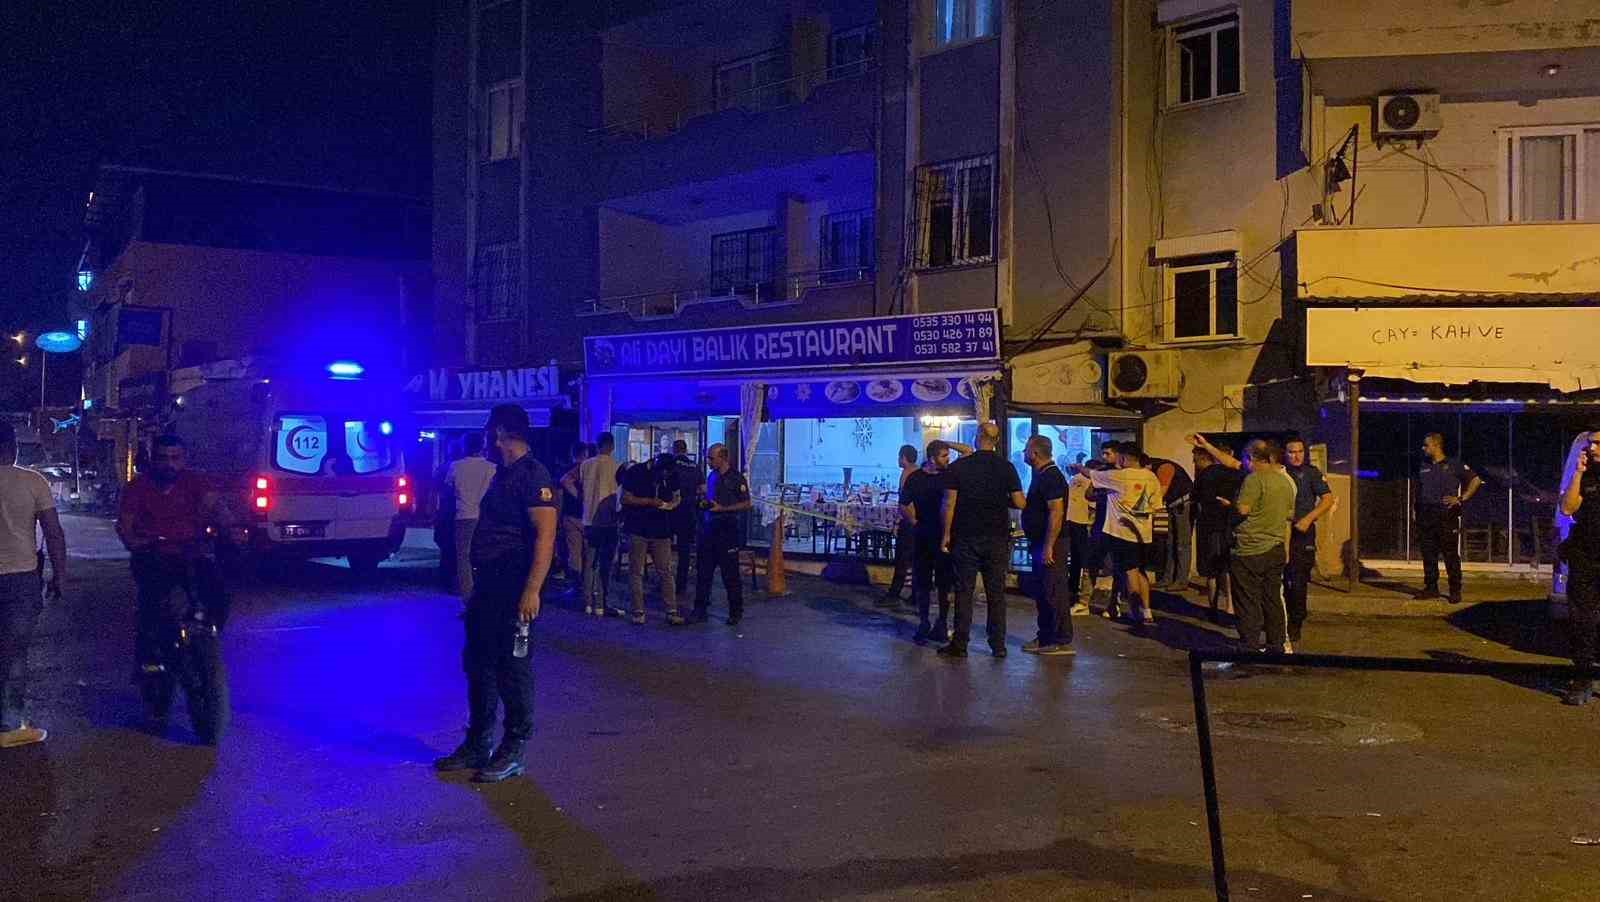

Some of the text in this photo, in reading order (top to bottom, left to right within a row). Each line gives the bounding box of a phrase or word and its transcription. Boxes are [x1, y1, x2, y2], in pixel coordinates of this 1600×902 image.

[941, 315, 962, 326] 330
[964, 313, 975, 324] 14
[978, 313, 992, 324] 94
[913, 327, 993, 341] 0530 426 71 89
[692, 335, 749, 362] BALIK
[754, 325, 896, 359] RESTAURANT
[914, 341, 993, 354] 0531 582 37 41
[294, 436, 320, 449] 112
